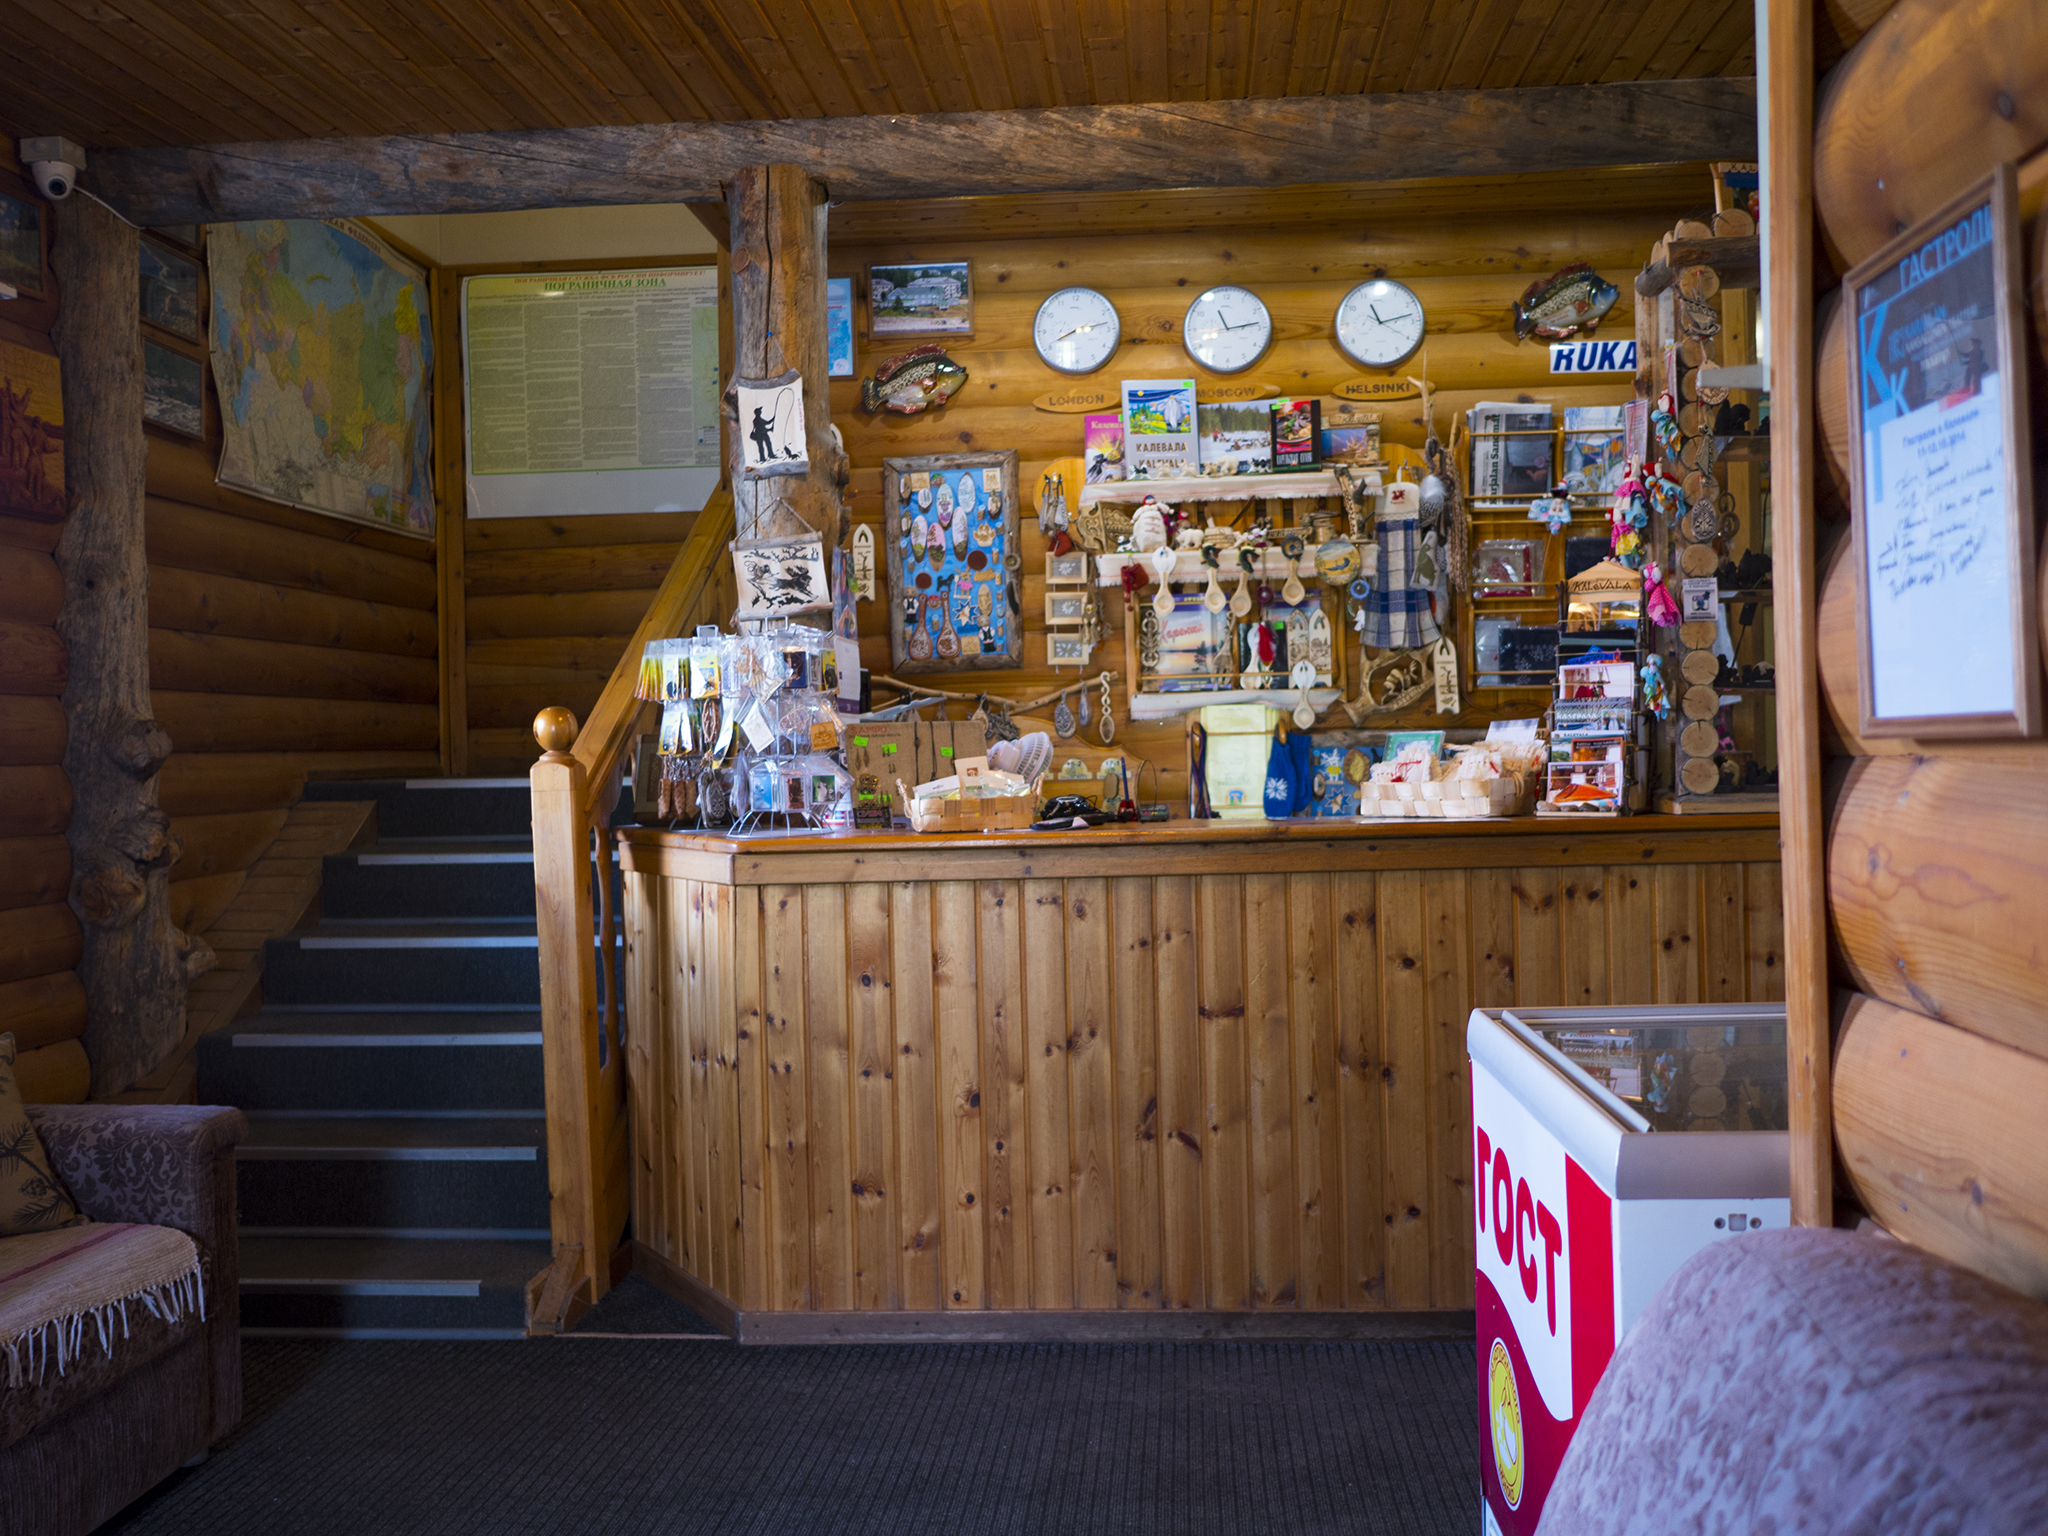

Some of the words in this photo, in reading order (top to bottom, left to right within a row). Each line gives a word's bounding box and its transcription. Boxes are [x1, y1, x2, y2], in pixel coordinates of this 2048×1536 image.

[544, 279, 633, 291] ПОГРАНИЧНАЯ
[635, 277, 667, 288] ЗОНА
[1552, 342, 1637, 371] RUKA
[1196, 387, 1256, 399] MOSCOW
[1345, 382, 1410, 395] HELSINKI
[1048, 394, 1104, 406] LONDON
[1136, 442, 1188, 453] КАЛЕВАЛА
[1488, 461, 1499, 505] Karjalan
[850, 725, 888, 735] SAMPO
